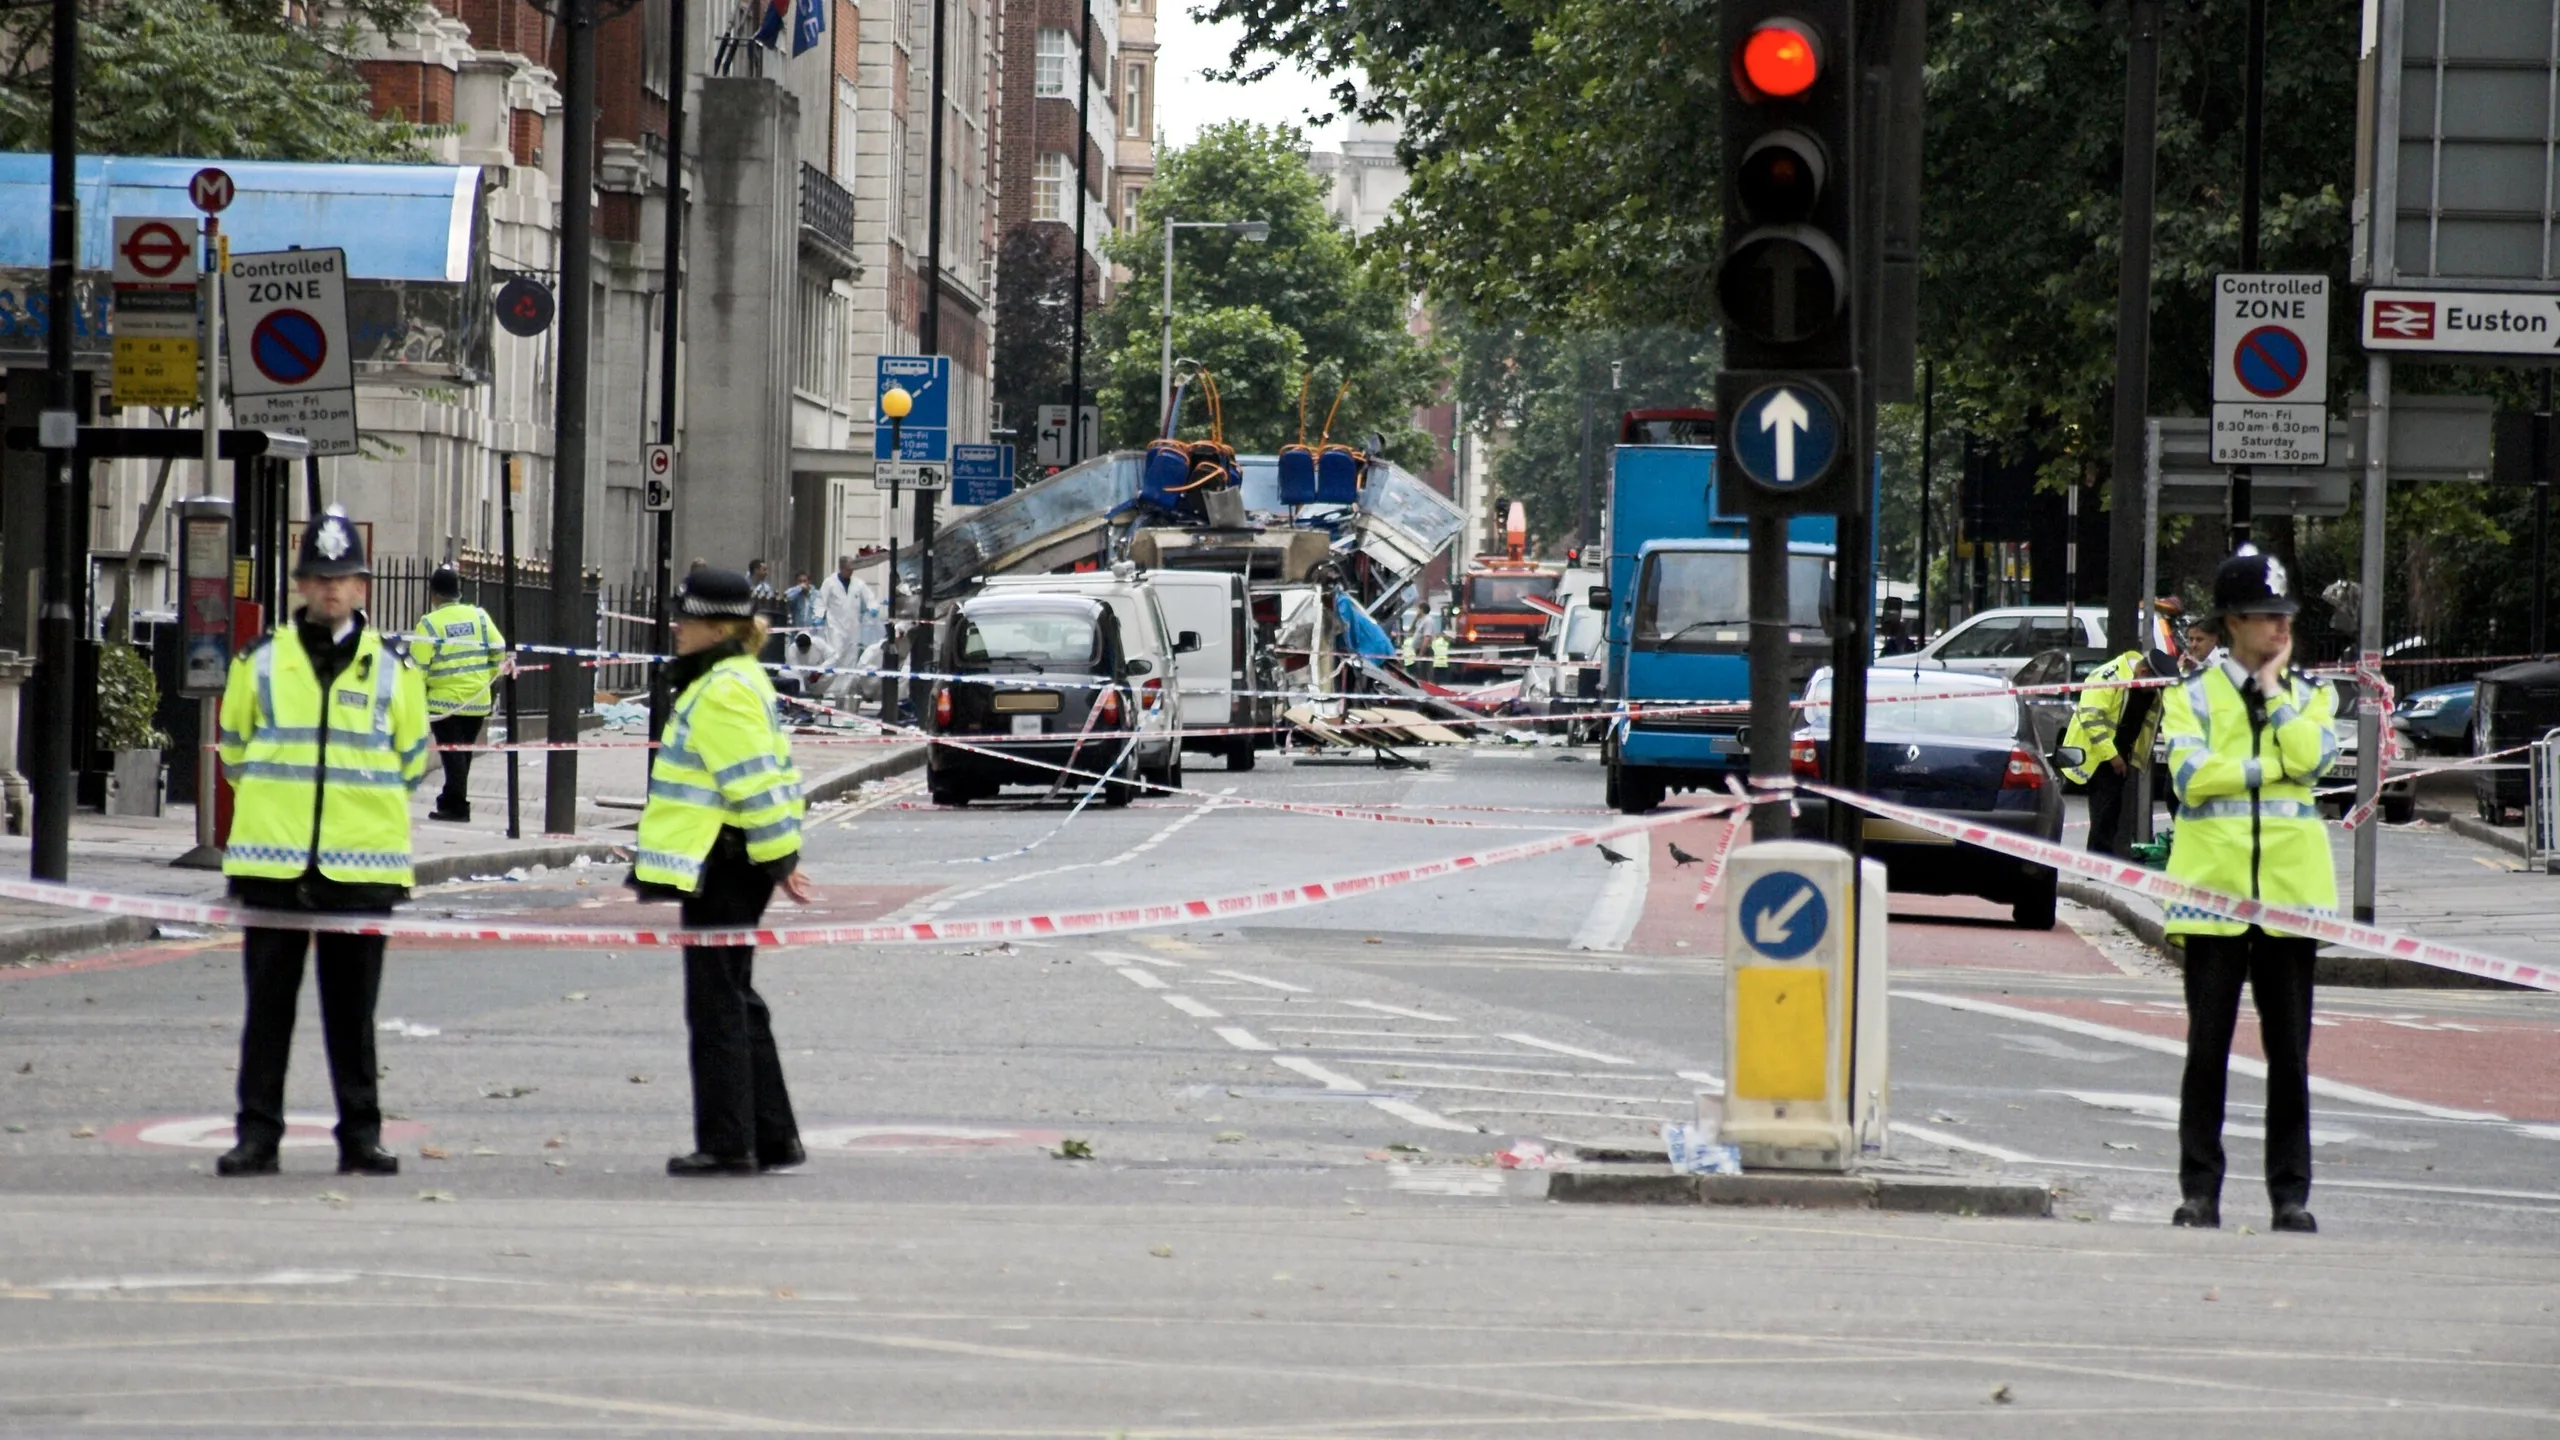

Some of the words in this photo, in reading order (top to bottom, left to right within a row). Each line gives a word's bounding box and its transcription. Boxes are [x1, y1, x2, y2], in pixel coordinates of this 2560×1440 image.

[196, 176, 227, 205] M
[232, 257, 334, 277] Controlled
[248, 280, 321, 302] ZONE
[2223, 279, 2322, 294] Controlled
[2235, 300, 2305, 319] ZONE
[2447, 308, 2547, 332] Euston
[267, 398, 293, 408] Mon
[303, 396, 319, 405] Fri
[330, 409, 349, 421] pm
[2243, 409, 2268, 420] Mon
[2276, 409, 2292, 420] Fri
[285, 427, 306, 436] Sat
[331, 440, 350, 451] pm
[2241, 436, 2295, 449] Saturday
